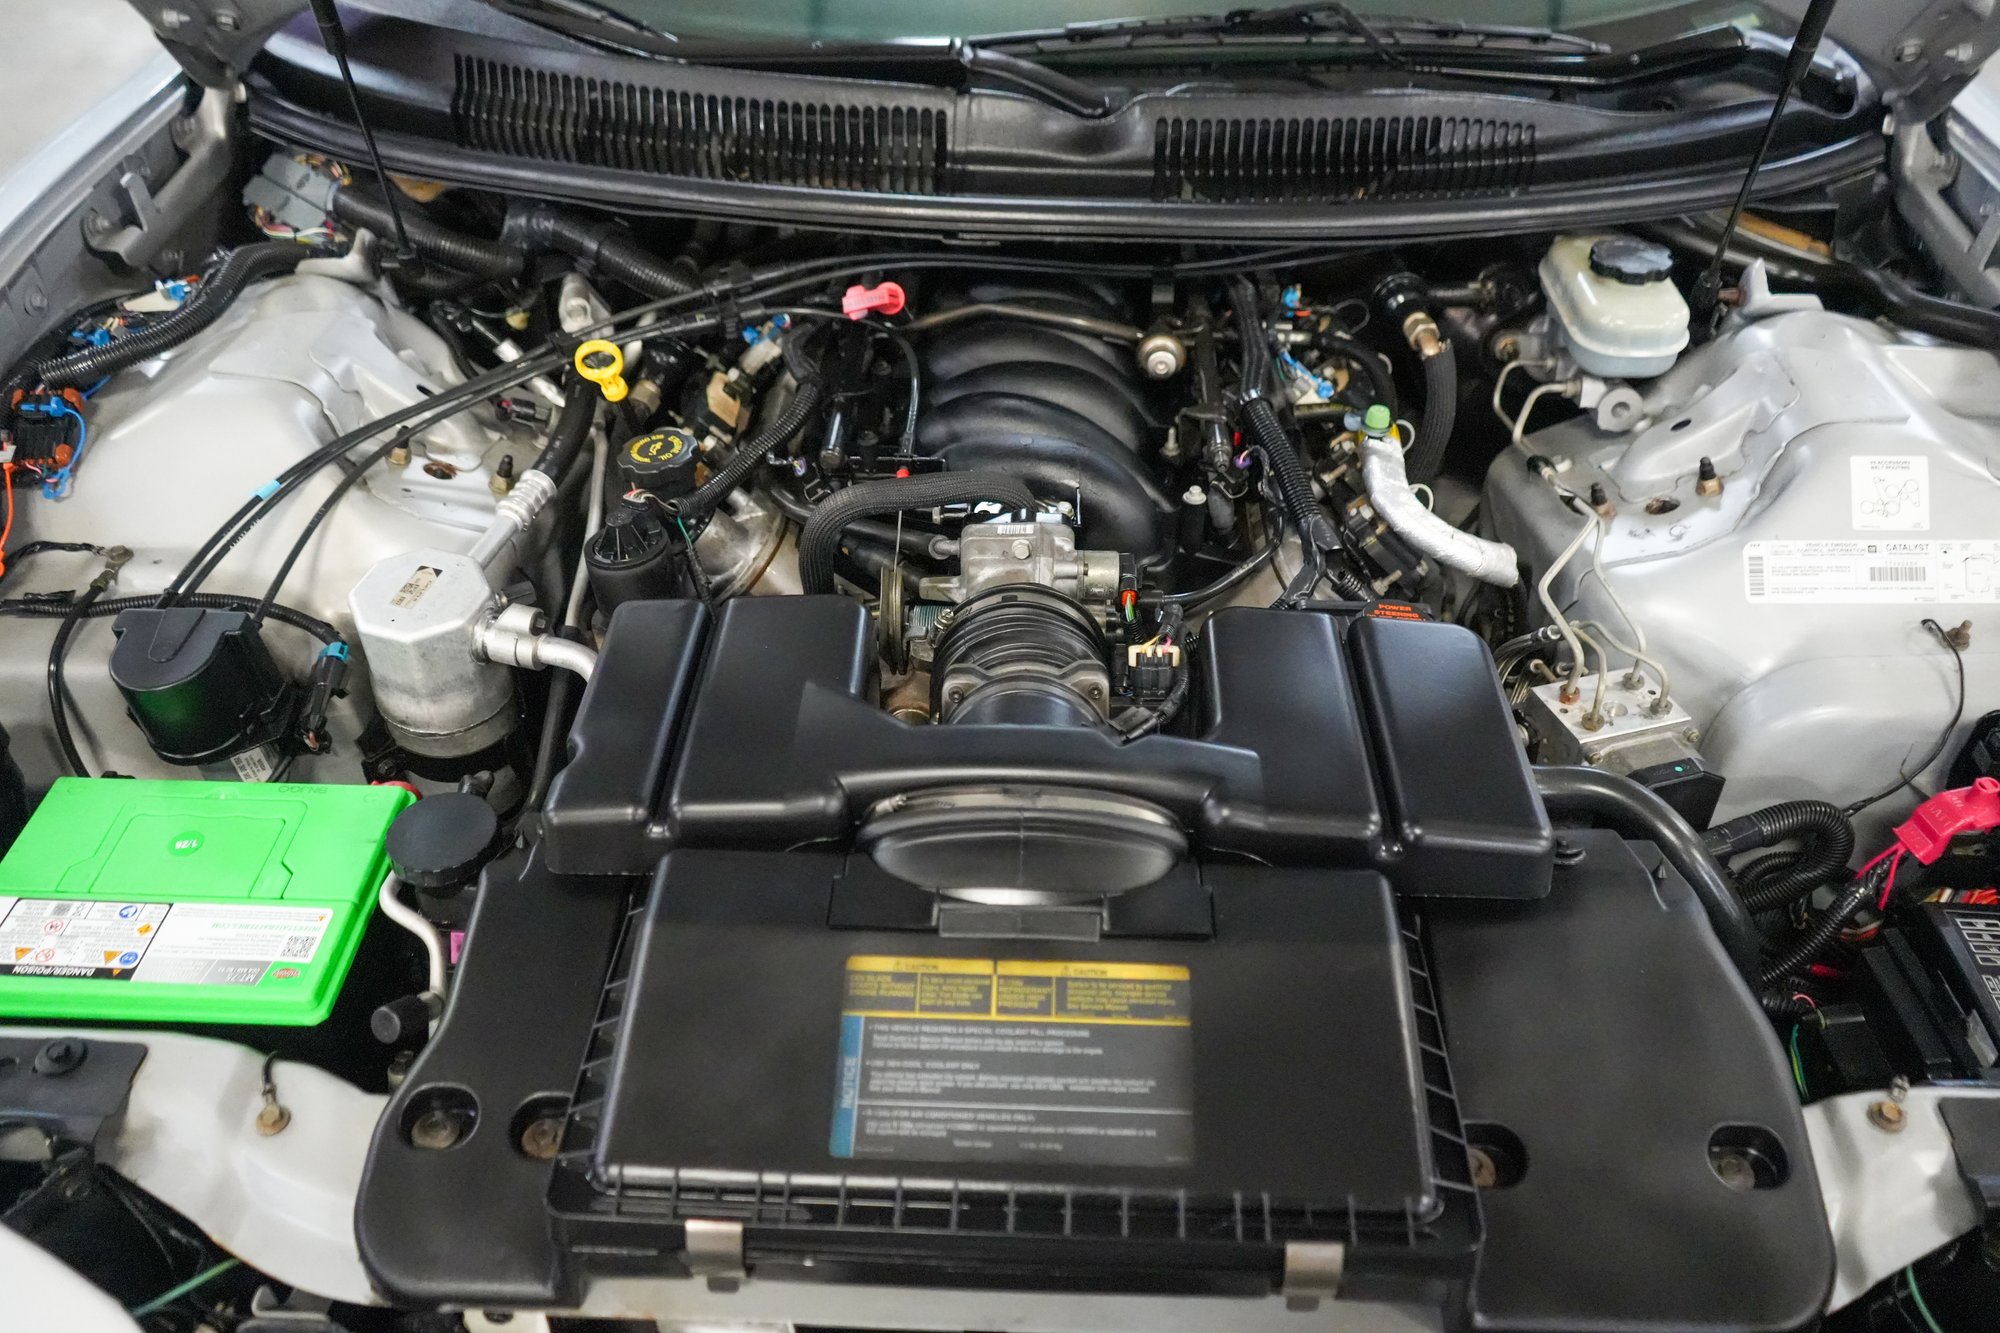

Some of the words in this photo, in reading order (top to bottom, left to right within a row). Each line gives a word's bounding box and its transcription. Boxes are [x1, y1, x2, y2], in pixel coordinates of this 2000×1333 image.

[1885, 543, 1930, 552] CATALYST
[1378, 604, 1412, 612] POWER
[11, 965, 97, 977] DANGER/POISON
[1073, 968, 1108, 977] CAUTION
[841, 1056, 858, 1109] NOTICE
